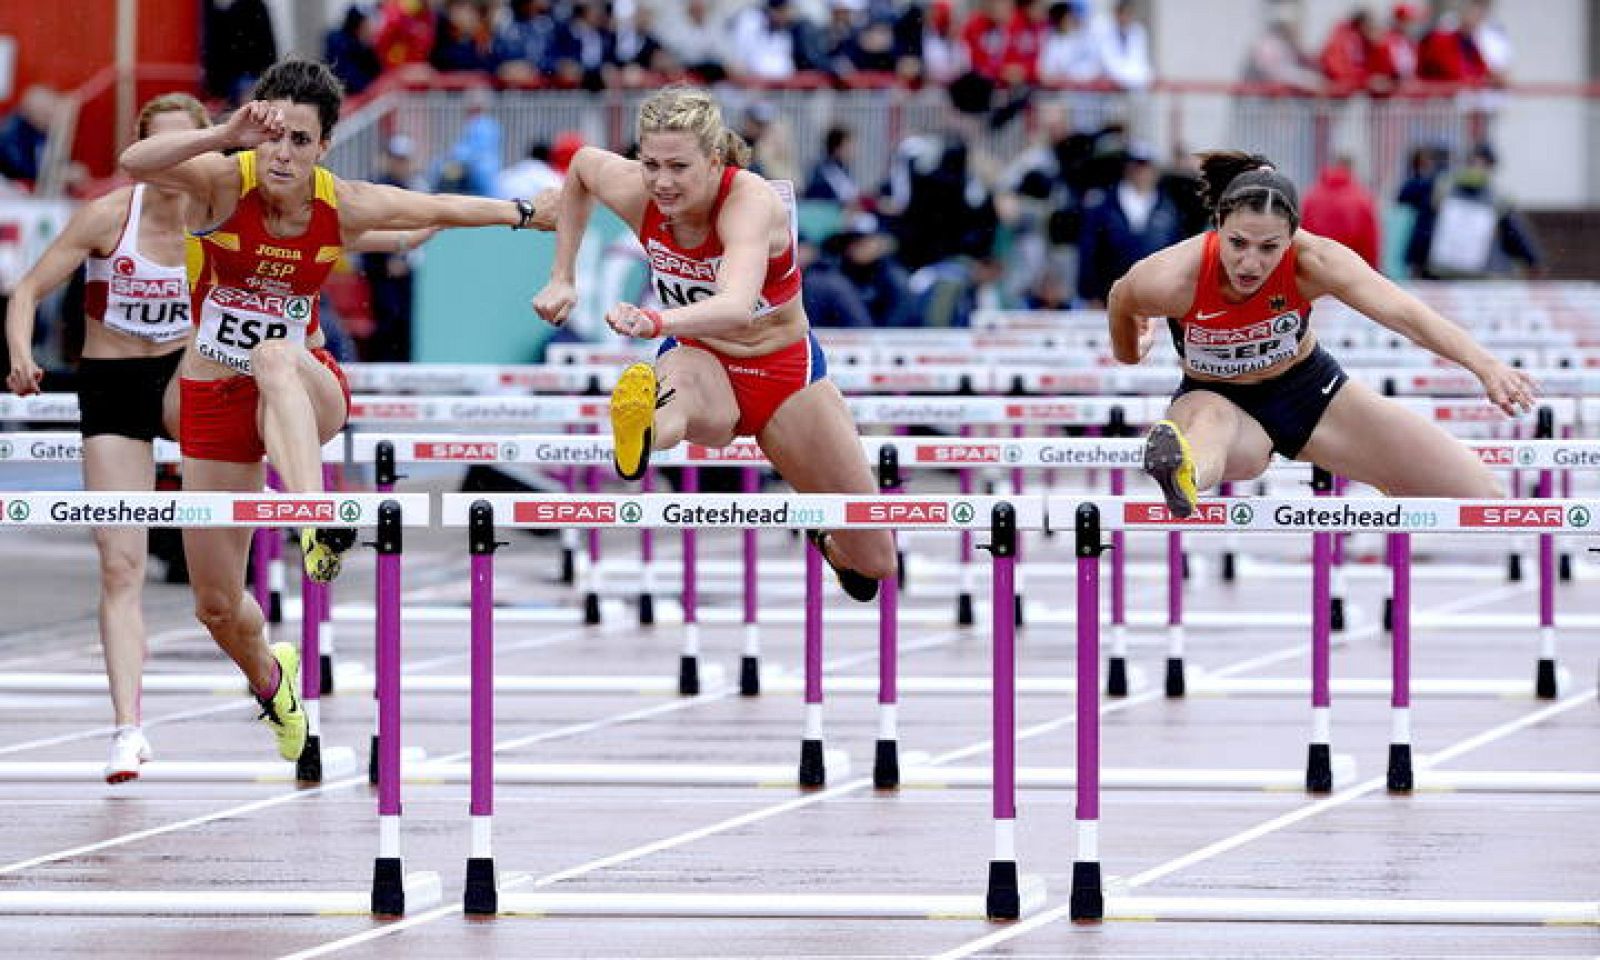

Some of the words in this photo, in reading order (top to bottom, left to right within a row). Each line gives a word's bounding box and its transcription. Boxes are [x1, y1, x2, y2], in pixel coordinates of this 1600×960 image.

[255, 259, 296, 277] ESP
[653, 253, 713, 280] SPAR
[113, 278, 181, 298] SPAR
[211, 286, 284, 316] SPAR
[119, 302, 189, 324] TUR
[1190, 322, 1271, 345] SPAR
[433, 442, 498, 459] SPAR
[536, 443, 614, 460] Gateshe
[933, 446, 999, 462] SPAR
[256, 503, 333, 519] SPAR
[537, 504, 615, 520] SPAR
[869, 505, 946, 521] SPAR
[1483, 508, 1561, 524] SPAR
